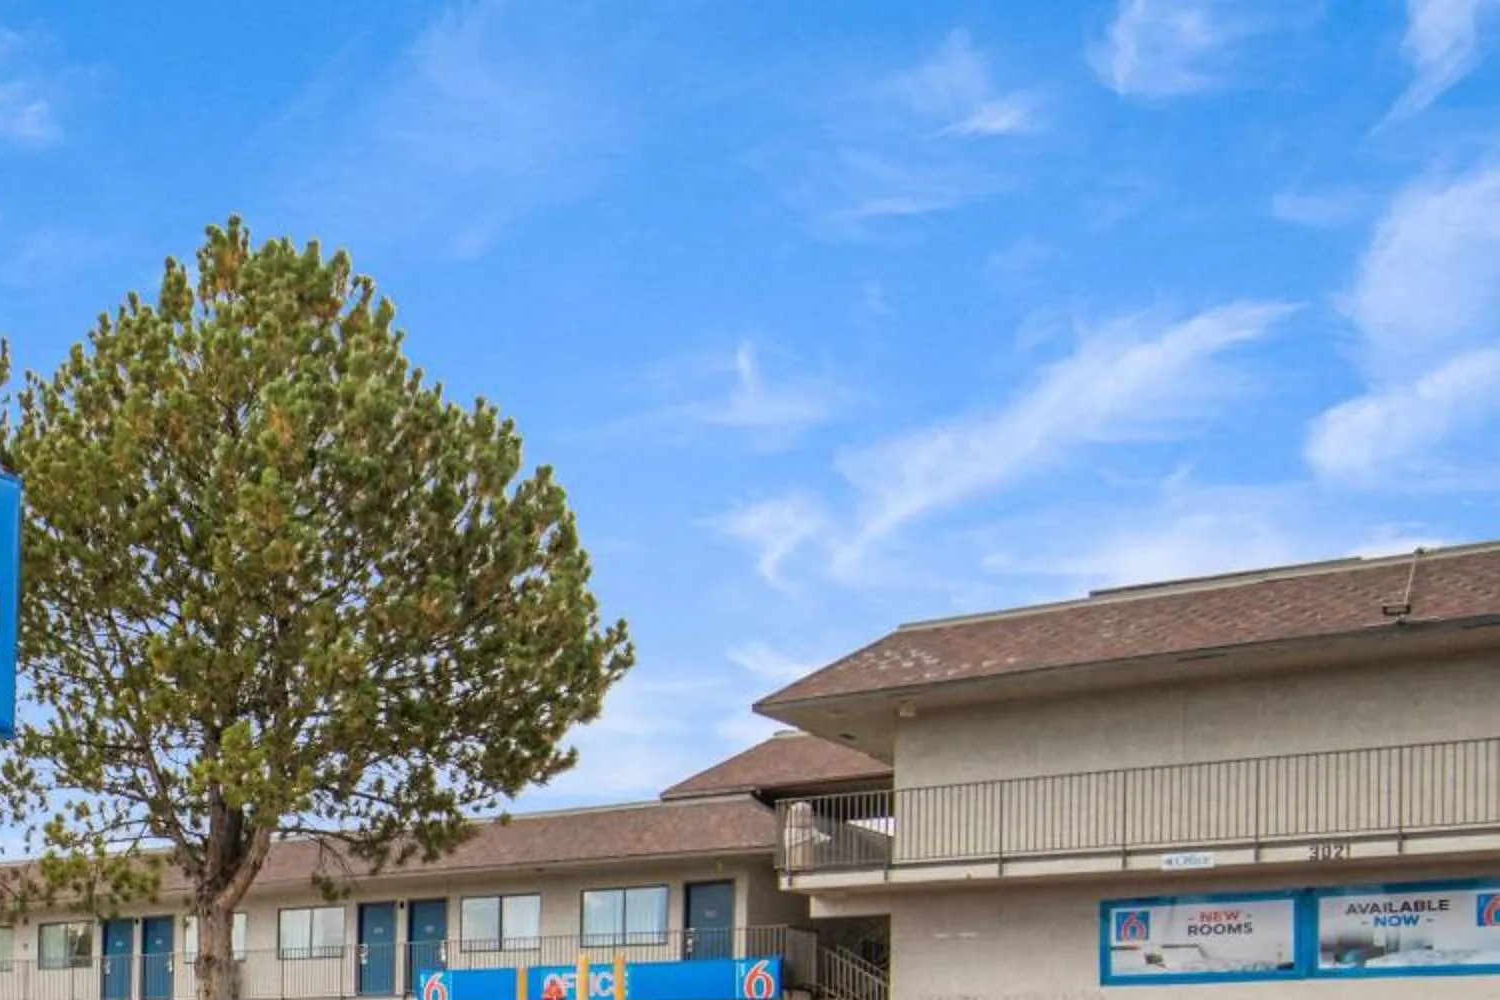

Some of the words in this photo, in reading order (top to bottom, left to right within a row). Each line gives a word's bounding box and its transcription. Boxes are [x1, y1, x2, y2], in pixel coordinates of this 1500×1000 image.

[1345, 899, 1451, 915] AVAILABLE
[1199, 910, 1240, 922] NEW
[1373, 915, 1421, 927] NOW
[1187, 922, 1253, 937] ROOMS
[743, 959, 775, 1000] 6
